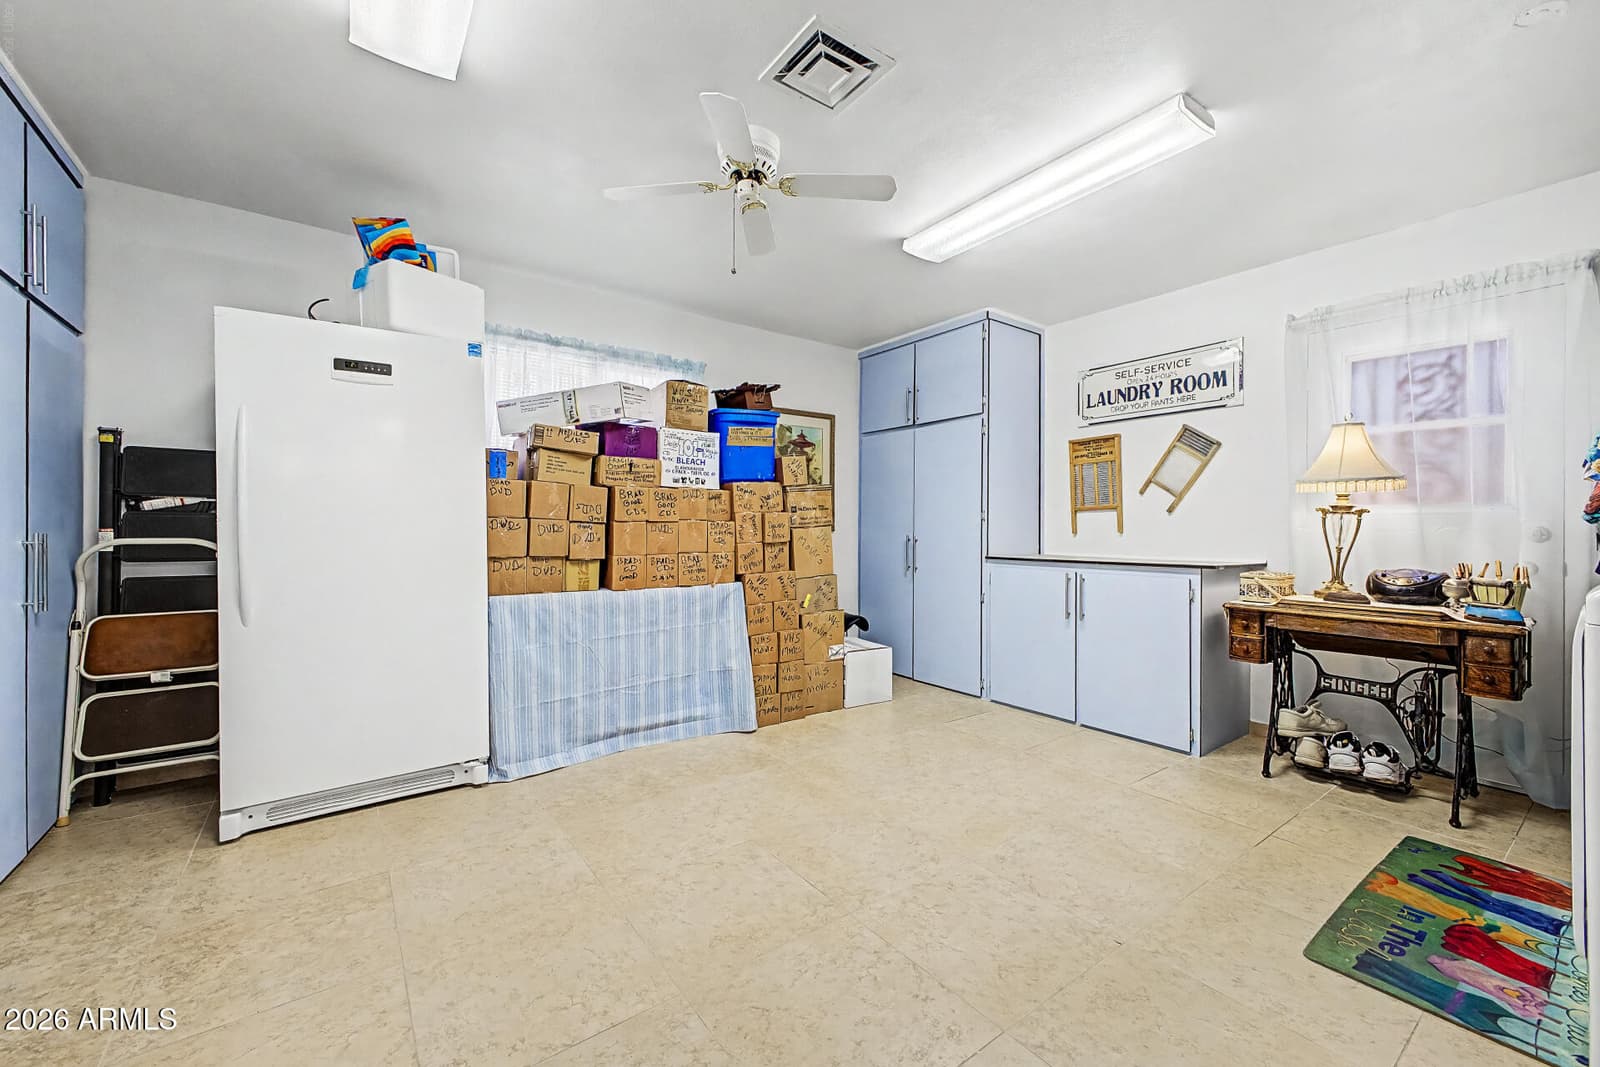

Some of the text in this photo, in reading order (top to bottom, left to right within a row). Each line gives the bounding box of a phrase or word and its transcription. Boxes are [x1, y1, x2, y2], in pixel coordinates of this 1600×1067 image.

[1114, 357, 1193, 380] SELF-SERVICE
[1086, 369, 1228, 409] LAUNDRY ROOM
[1110, 393, 1197, 413] DROP YOUR PANTS HERE
[676, 457, 706, 466] BLEACH
[619, 490, 645, 499] BRAD
[783, 632, 801, 644] VHS
[807, 665, 830, 681] VHS
[1320, 677, 1391, 699] SINGER
[1378, 904, 1437, 957] In The
